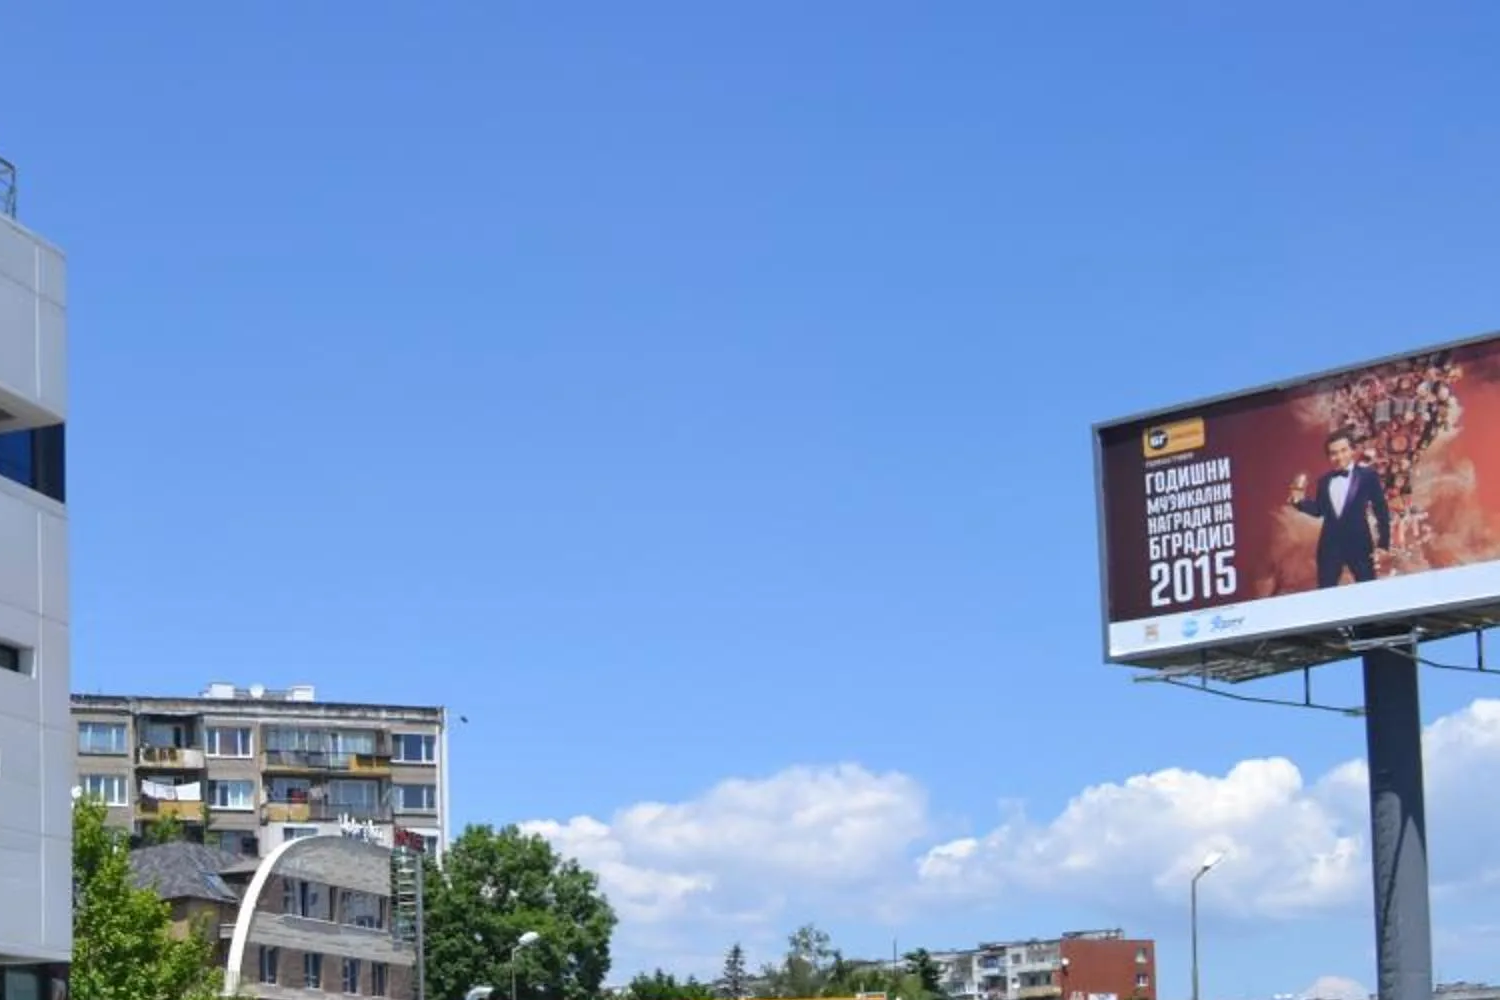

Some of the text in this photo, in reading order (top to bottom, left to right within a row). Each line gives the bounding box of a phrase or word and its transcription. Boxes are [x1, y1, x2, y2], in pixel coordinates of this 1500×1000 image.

[1145, 457, 1231, 495] ГОДИШНИ
[1146, 482, 1232, 515] МУЗИКАЛНИ
[1148, 501, 1233, 535] НАГРАДИ НА
[1150, 549, 1237, 608] 2015
